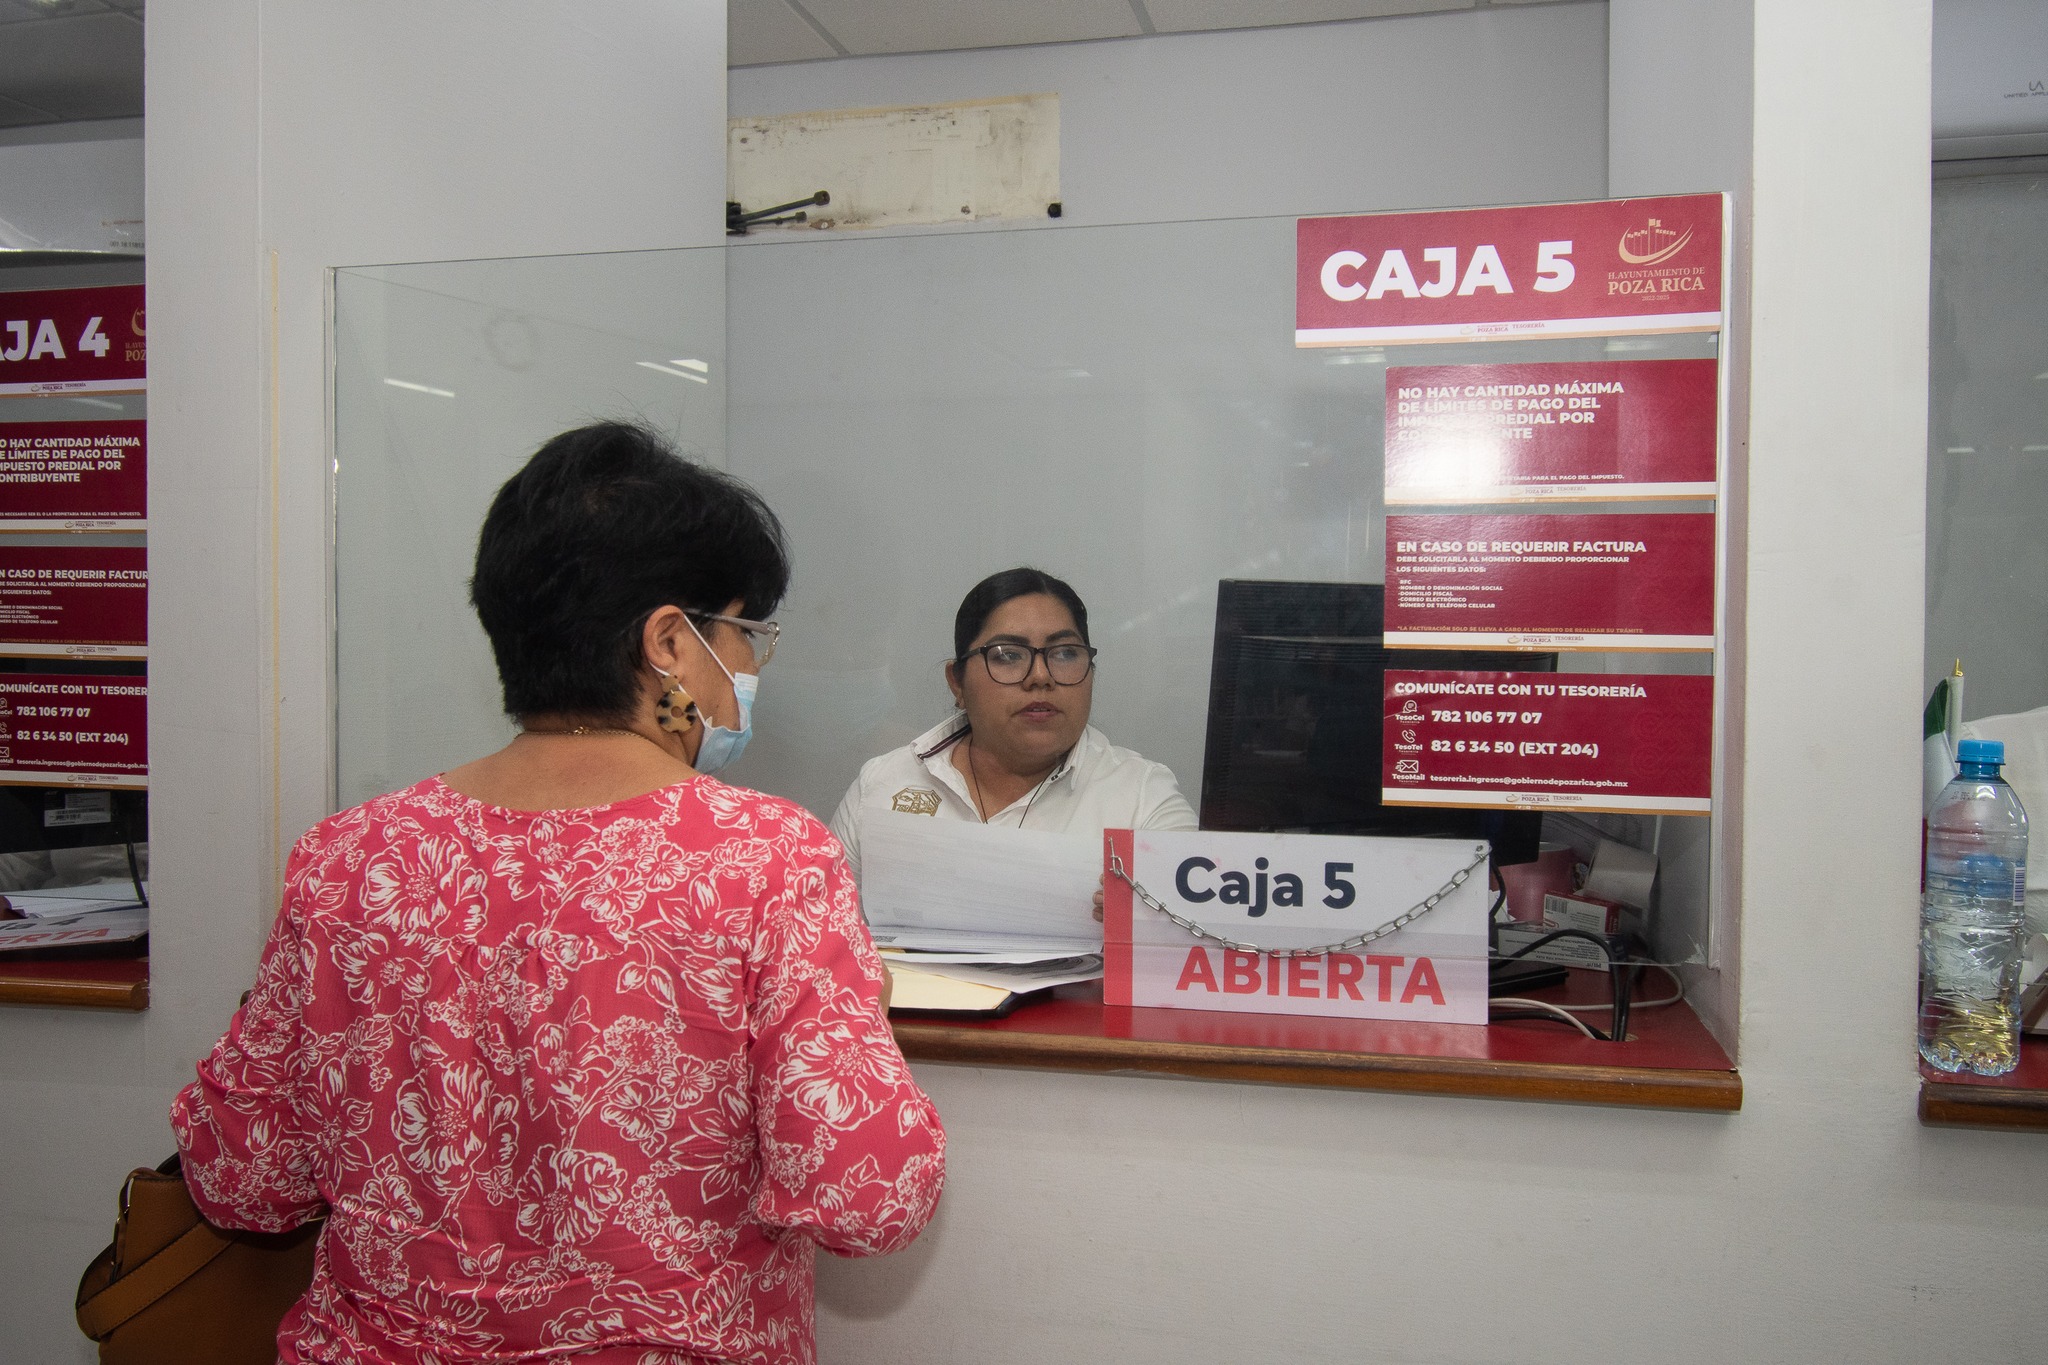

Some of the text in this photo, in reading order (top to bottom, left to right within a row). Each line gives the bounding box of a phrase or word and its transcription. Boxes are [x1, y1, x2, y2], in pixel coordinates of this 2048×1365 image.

[1321, 240, 1575, 301] CAJA 5
[1692, 267, 1705, 275] DE
[1607, 276, 1705, 295] POZA RICA
[0, 316, 110, 361] JA 4
[1398, 380, 1625, 400] NO HAY CANTIDAD MÁXIMA
[1398, 396, 1601, 414] DE LÍMITES DE PAGO DEL
[1560, 412, 1595, 424] POR
[9, 435, 141, 448] HAY CANTIDAD MÁXIMA
[8, 448, 125, 460] LÍMITES DE PAGO DEL
[48, 461, 95, 471] PREDIAL
[98, 461, 121, 470] POR
[1397, 541, 1647, 554] EN CASO DE REQUERIR FACTURA
[8, 570, 36, 578] CASO
[38, 570, 52, 578] DE
[54, 570, 106, 580] REQUERIR
[60, 685, 83, 694] CON
[85, 686, 99, 694] TU
[1394, 681, 1647, 698] COMUNÍCATE CON TU TESORERÍA
[17, 706, 90, 717] 782 106 77 07
[1431, 710, 1542, 724] 782 106 77 07
[17, 731, 129, 745] 82 6 34 50 (EXT 204)
[1430, 740, 1599, 759] 82 6 34 50 (EXT 204)
[1175, 856, 1356, 917] Caja 5
[1175, 946, 1446, 1005] ABIERTA
